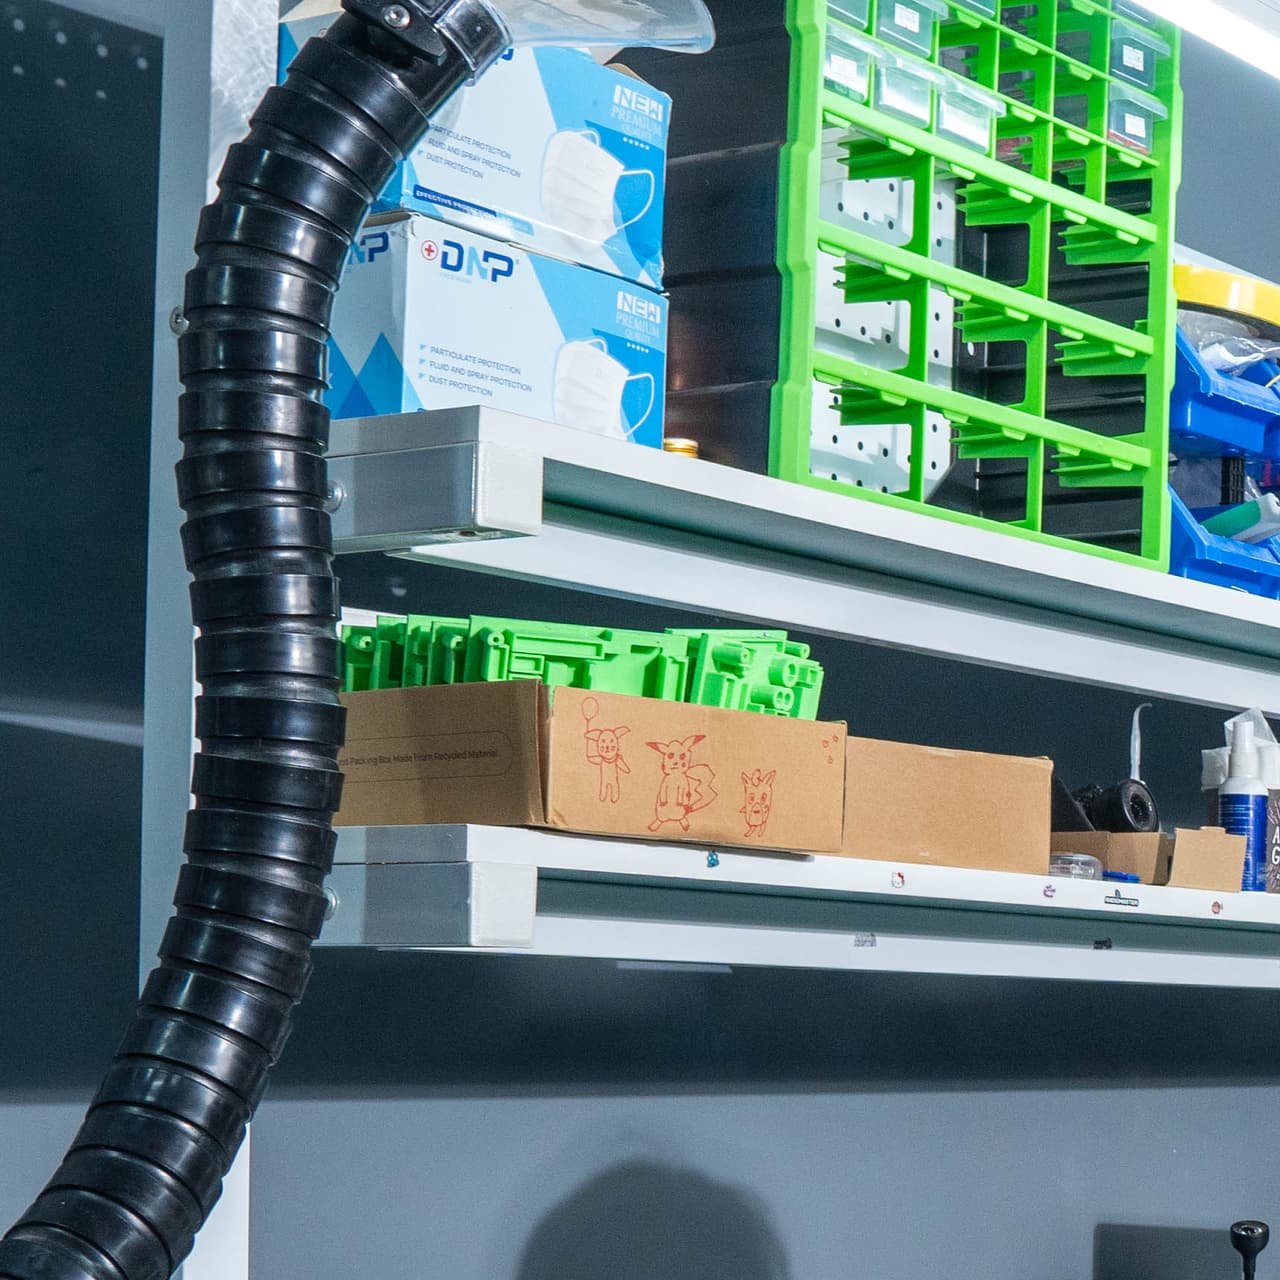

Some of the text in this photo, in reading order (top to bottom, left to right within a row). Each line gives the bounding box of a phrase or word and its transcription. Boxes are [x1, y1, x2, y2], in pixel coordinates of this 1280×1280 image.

[613, 85, 664, 122] NEW
[472, 138, 512, 160] PROTECTION
[426, 152, 484, 178] DUST PROTECTION
[481, 158, 521, 178] PROTECTION
[347, 231, 389, 265] NP
[440, 239, 514, 283] DNP
[617, 291, 661, 325] NEW
[430, 346, 522, 375] PARTICULATE PROTECTION
[428, 375, 494, 397] DUST PROTECTION
[429, 360, 533, 392] FLUID AND SPRAY PROTECTION
[378, 755, 393, 763] Box
[393, 753, 413, 762] Made
[414, 752, 433, 761] From
[433, 750, 467, 761] Recycled
